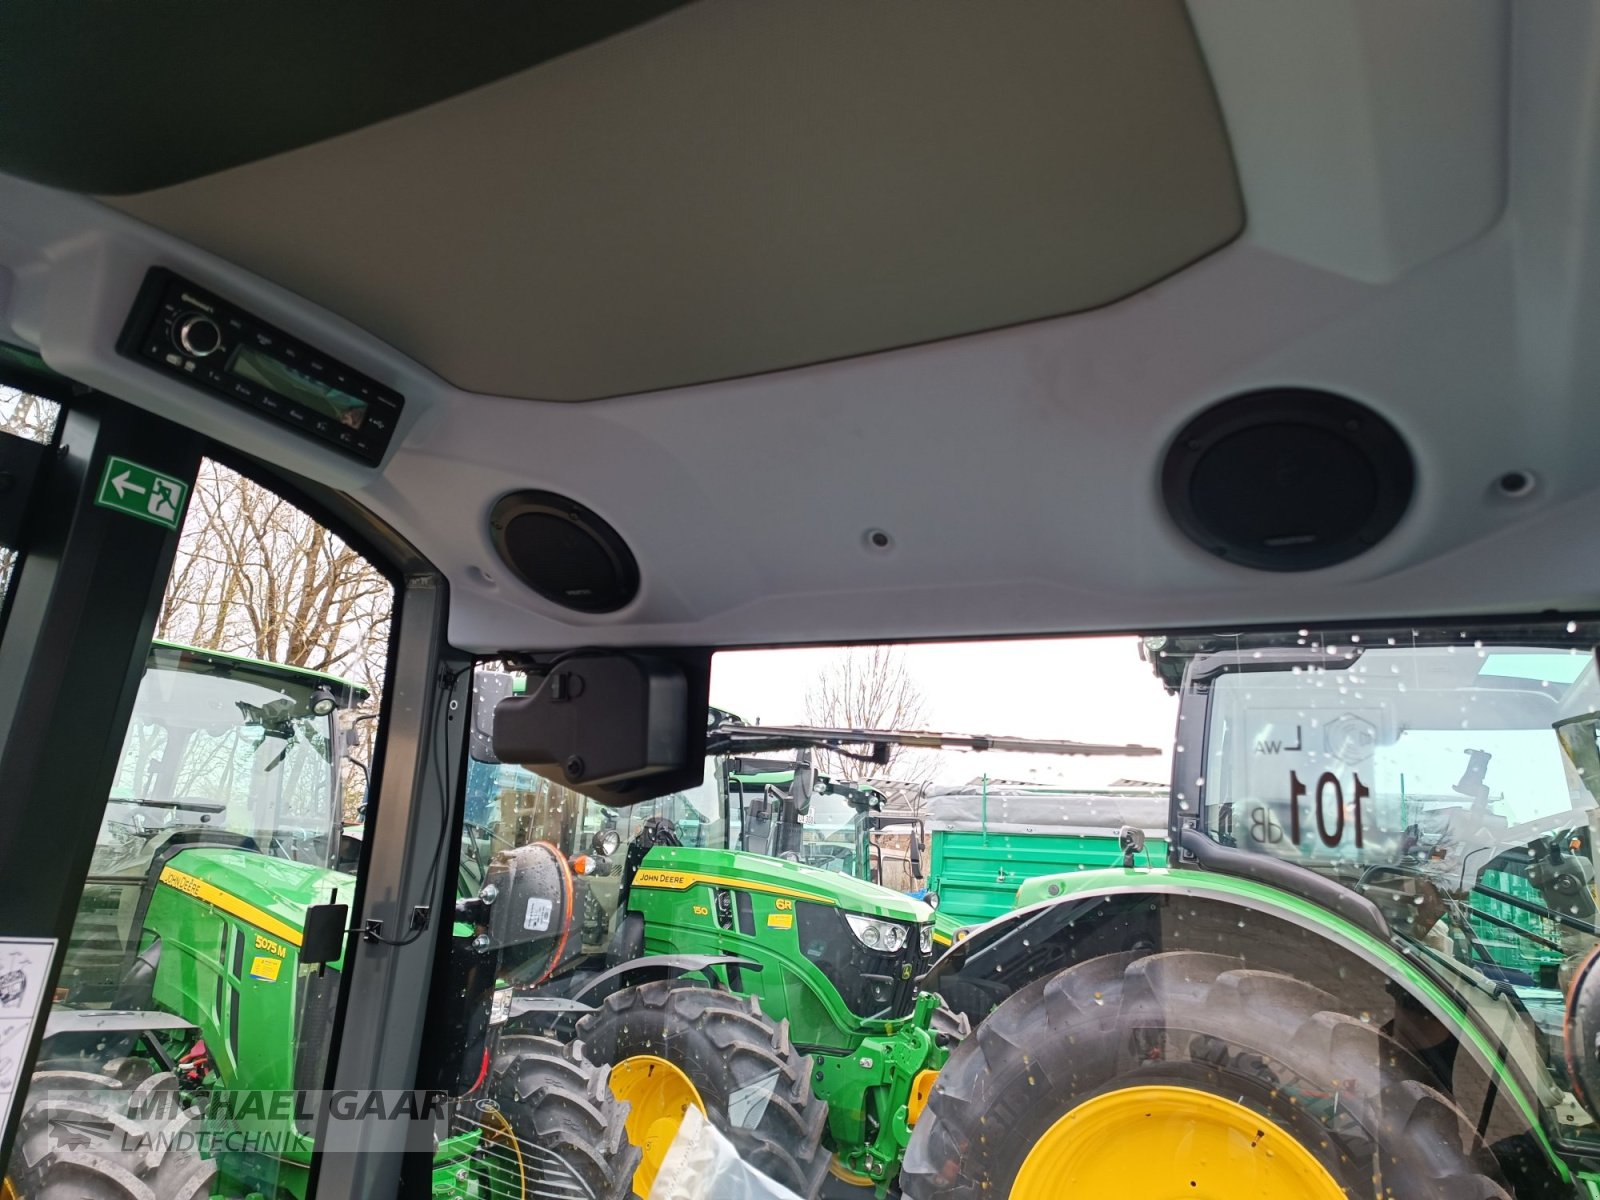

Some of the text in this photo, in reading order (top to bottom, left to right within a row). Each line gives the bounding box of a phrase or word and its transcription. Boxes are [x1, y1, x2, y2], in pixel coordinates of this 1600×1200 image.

[639, 873, 685, 884] JOHN DEERE
[179, 876, 201, 896] DEERE
[775, 898, 793, 910] 6R
[693, 906, 709, 916] 150
